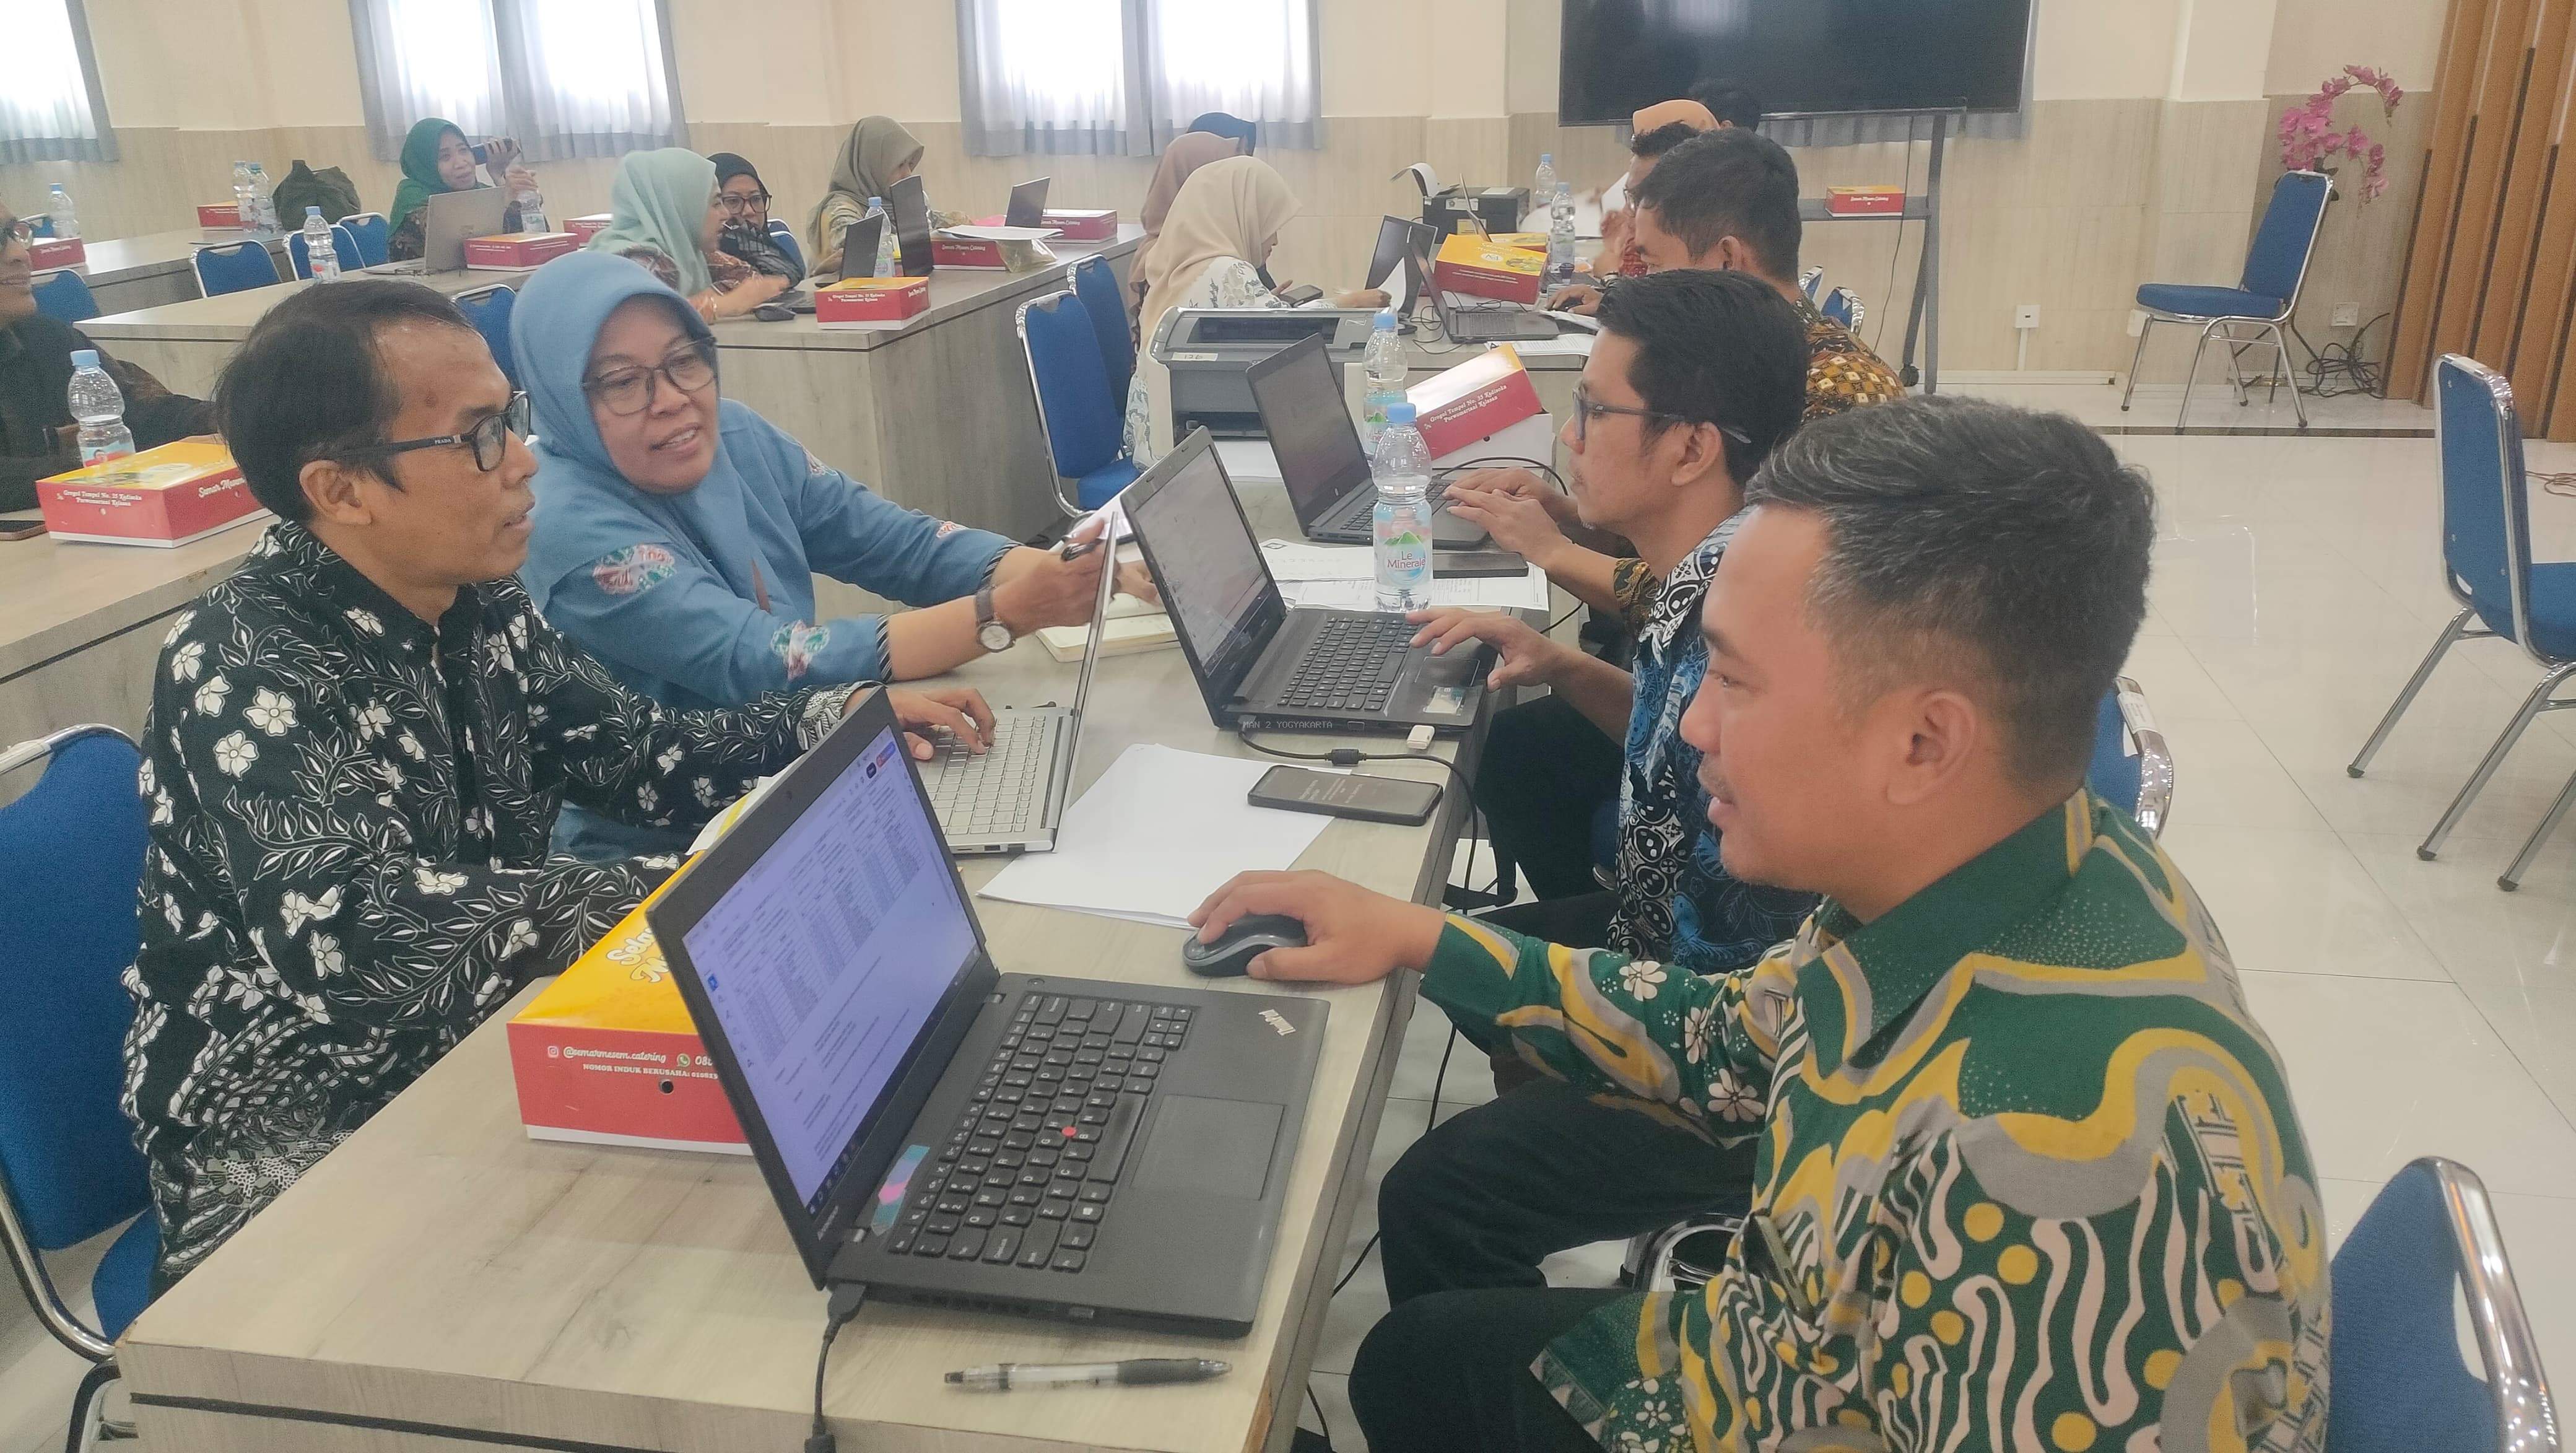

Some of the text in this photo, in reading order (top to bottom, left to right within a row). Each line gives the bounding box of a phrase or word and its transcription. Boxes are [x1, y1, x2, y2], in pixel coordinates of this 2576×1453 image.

[1401, 551, 1412, 561] Le
[1387, 558, 1425, 569] Minerale
[606, 927, 655, 966] Sela
[583, 1063, 613, 1072] NOMOR
